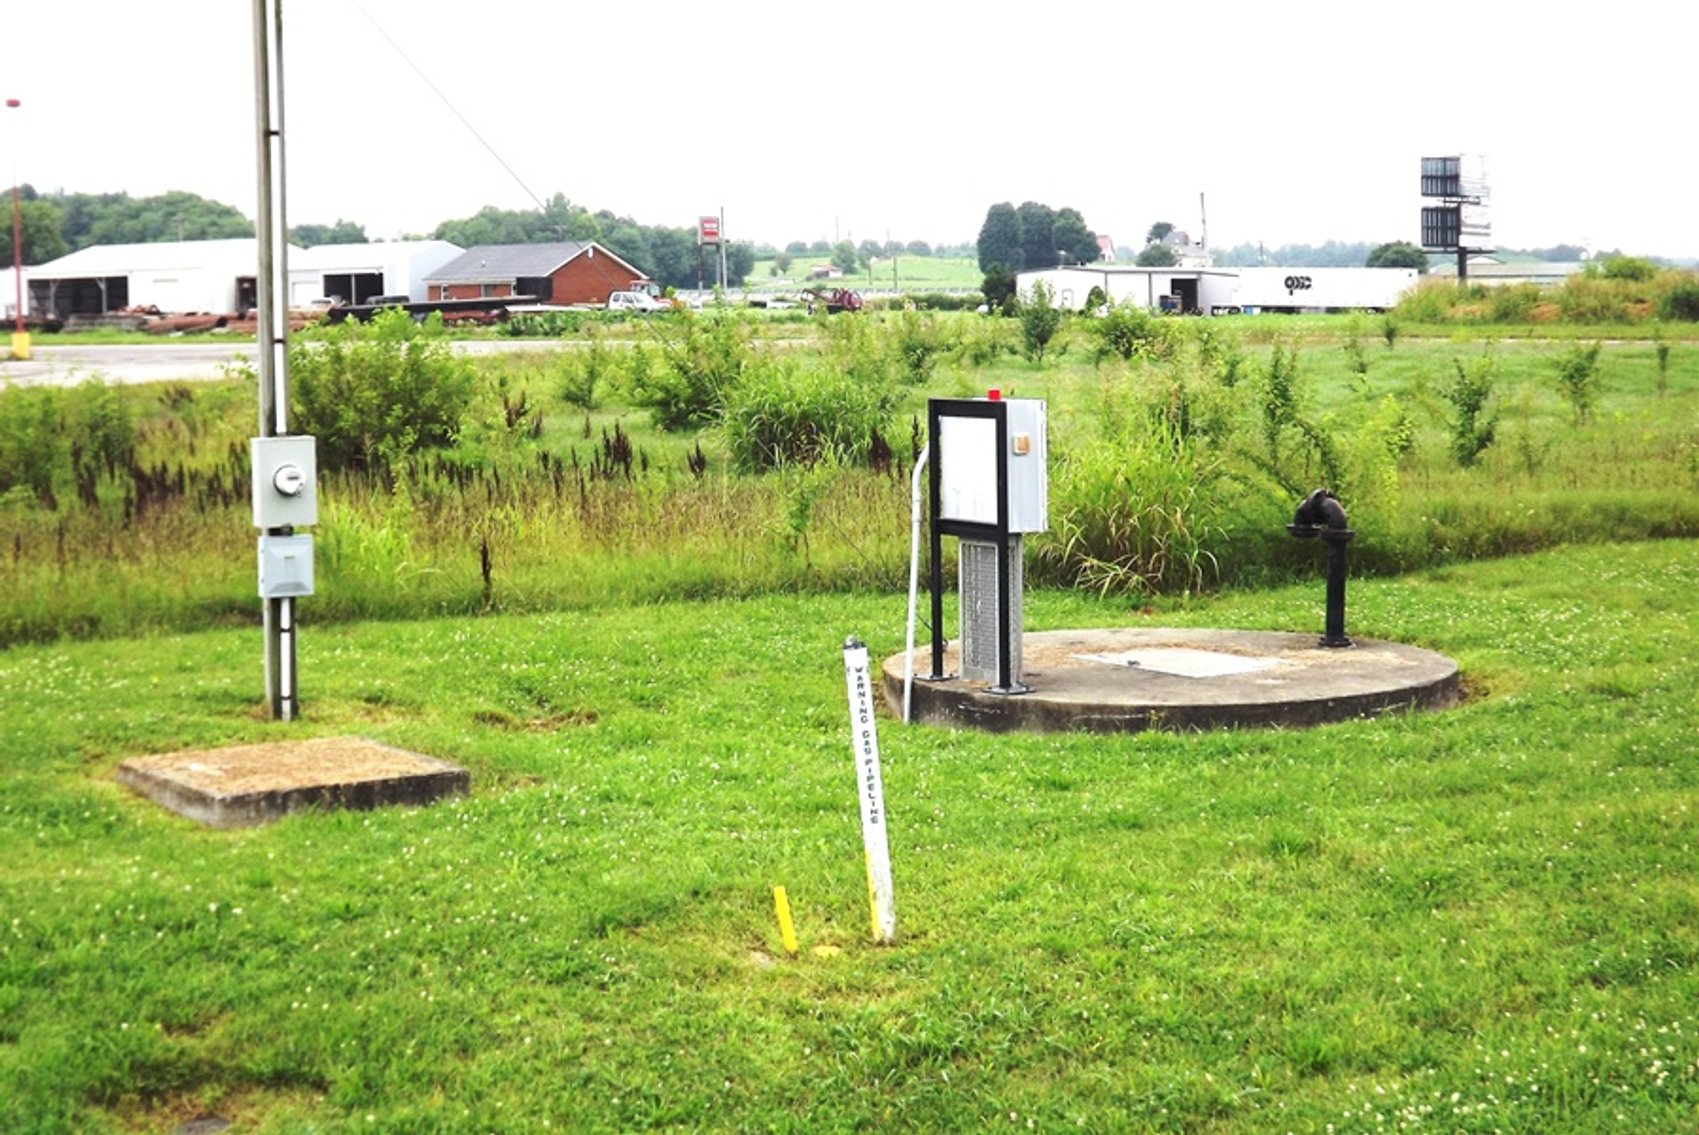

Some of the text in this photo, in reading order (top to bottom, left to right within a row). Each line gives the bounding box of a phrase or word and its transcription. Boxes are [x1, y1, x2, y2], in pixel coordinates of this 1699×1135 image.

[854, 666, 878, 824] WARNING GAS PIPELINE
